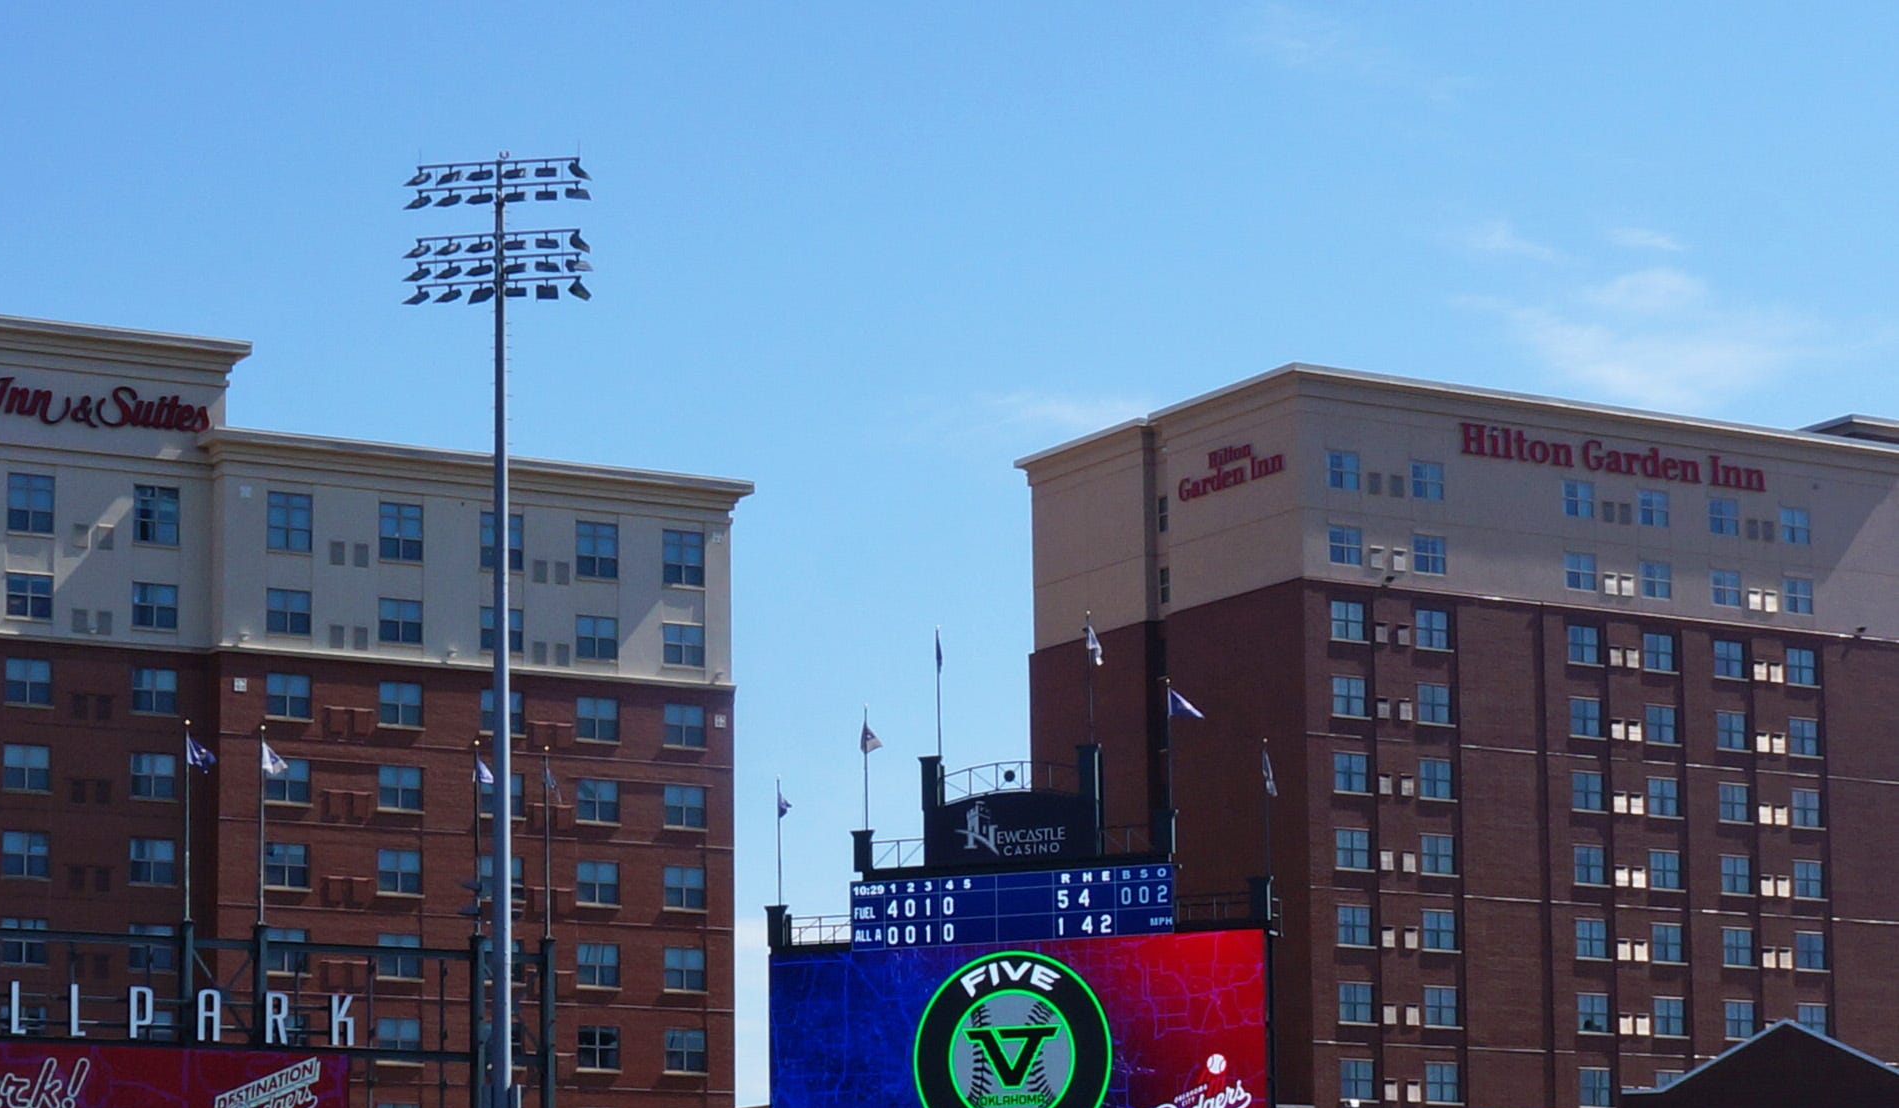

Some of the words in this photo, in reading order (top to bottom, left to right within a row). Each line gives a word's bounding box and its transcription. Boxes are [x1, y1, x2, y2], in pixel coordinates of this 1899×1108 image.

[69, 394, 99, 428] &
[96, 386, 210, 433] Suites
[1207, 444, 1251, 469] Hilton
[1459, 422, 1574, 468] Hilton
[1581, 437, 1703, 485] Garden
[1708, 454, 1766, 492] Inn
[1178, 466, 1245, 501] Garden
[1249, 453, 1284, 480] Inn
[1003, 842, 1060, 856] CASINO
[853, 884, 885, 896] 10:29
[889, 883, 896, 894] 1
[906, 882, 915, 893] 2
[924, 881, 933, 892] 3
[945, 879, 954, 890] 4
[963, 878, 971, 889] 5
[1060, 873, 1071, 884] R
[1082, 871, 1093, 883] H
[1101, 870, 1111, 882] E
[1122, 869, 1131, 880] B
[1139, 868, 1149, 879] S
[854, 906, 876, 920] FUEL
[887, 899, 898, 919] 4
[904, 898, 916, 918] 0
[925, 897, 931, 917] 1
[943, 896, 954, 915] 0
[1120, 886, 1132, 905] 0
[1138, 885, 1150, 904] 0
[1157, 884, 1169, 903] 2
[854, 929, 872, 943] ALL
[874, 928, 883, 942] A
[887, 926, 899, 945] 0
[904, 925, 916, 944] 0
[925, 924, 931, 943] 1
[943, 922, 955, 942] 0
[1058, 916, 1064, 936] 1
[1081, 915, 1094, 935] 4
[1100, 914, 1112, 934] 2
[1149, 916, 1173, 927] MPH
[960, 960, 1062, 998] FIVE
[980, 1094, 1046, 1107] OKLAHOMA
